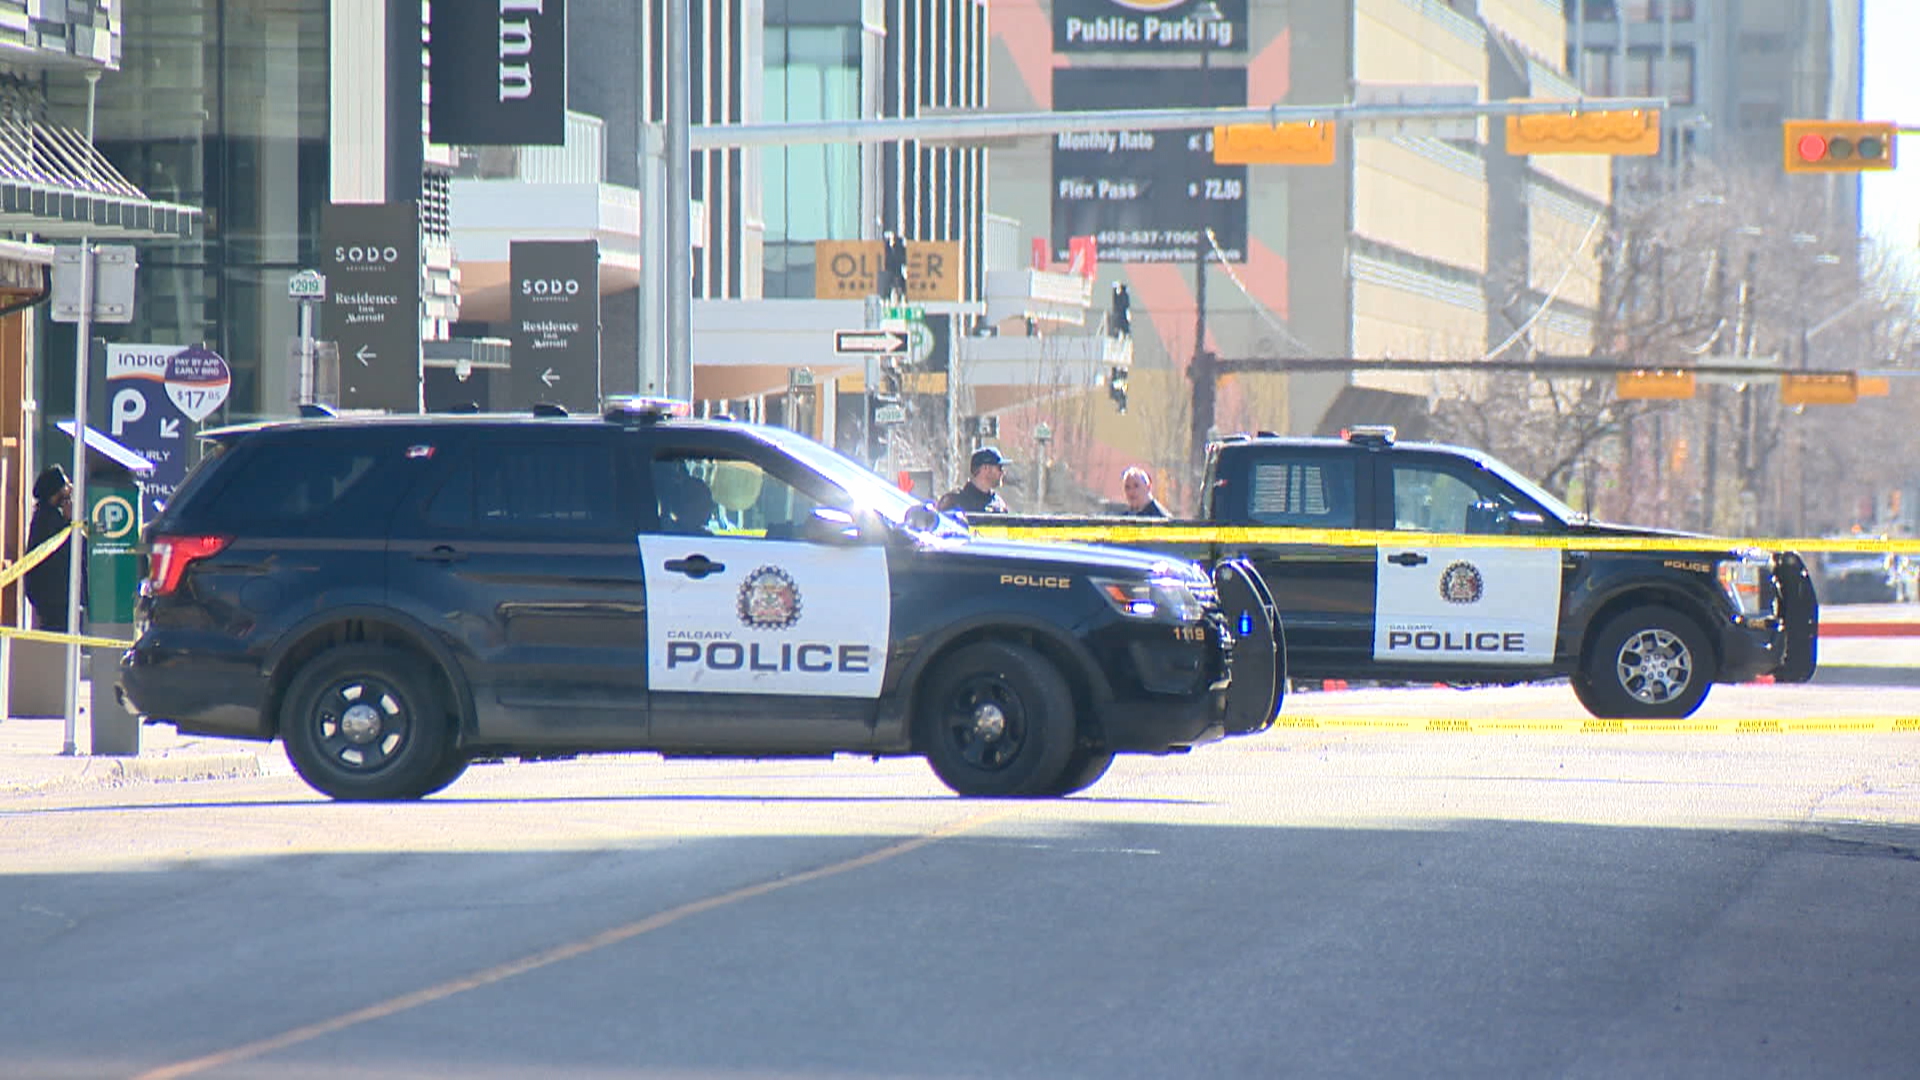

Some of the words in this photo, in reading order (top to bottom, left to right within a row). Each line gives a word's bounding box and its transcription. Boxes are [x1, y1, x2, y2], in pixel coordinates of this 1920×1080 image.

[1066, 17, 1140, 42] Public
[1058, 131, 1117, 153] Monthly
[1119, 131, 1154, 150] Rate
[1059, 180, 1095, 199] Flex
[1098, 179, 1137, 199] Pass
[335, 247, 398, 262] SODO
[522, 279, 579, 295] SODO
[335, 293, 398, 304] Residence
[522, 321, 579, 332] Residence
[175, 358, 190, 367] PAY
[191, 358, 202, 367] BY
[203, 358, 220, 367] APP
[175, 367, 200, 375] EARLY
[201, 367, 220, 376] BIRD
[1663, 561, 1710, 572] POLICE
[1000, 575, 1071, 589] POLICE
[667, 631, 733, 640] CALGARY
[1173, 627, 1205, 641] 1119
[1389, 631, 1525, 652] POLICE
[667, 641, 870, 672] POLICE
